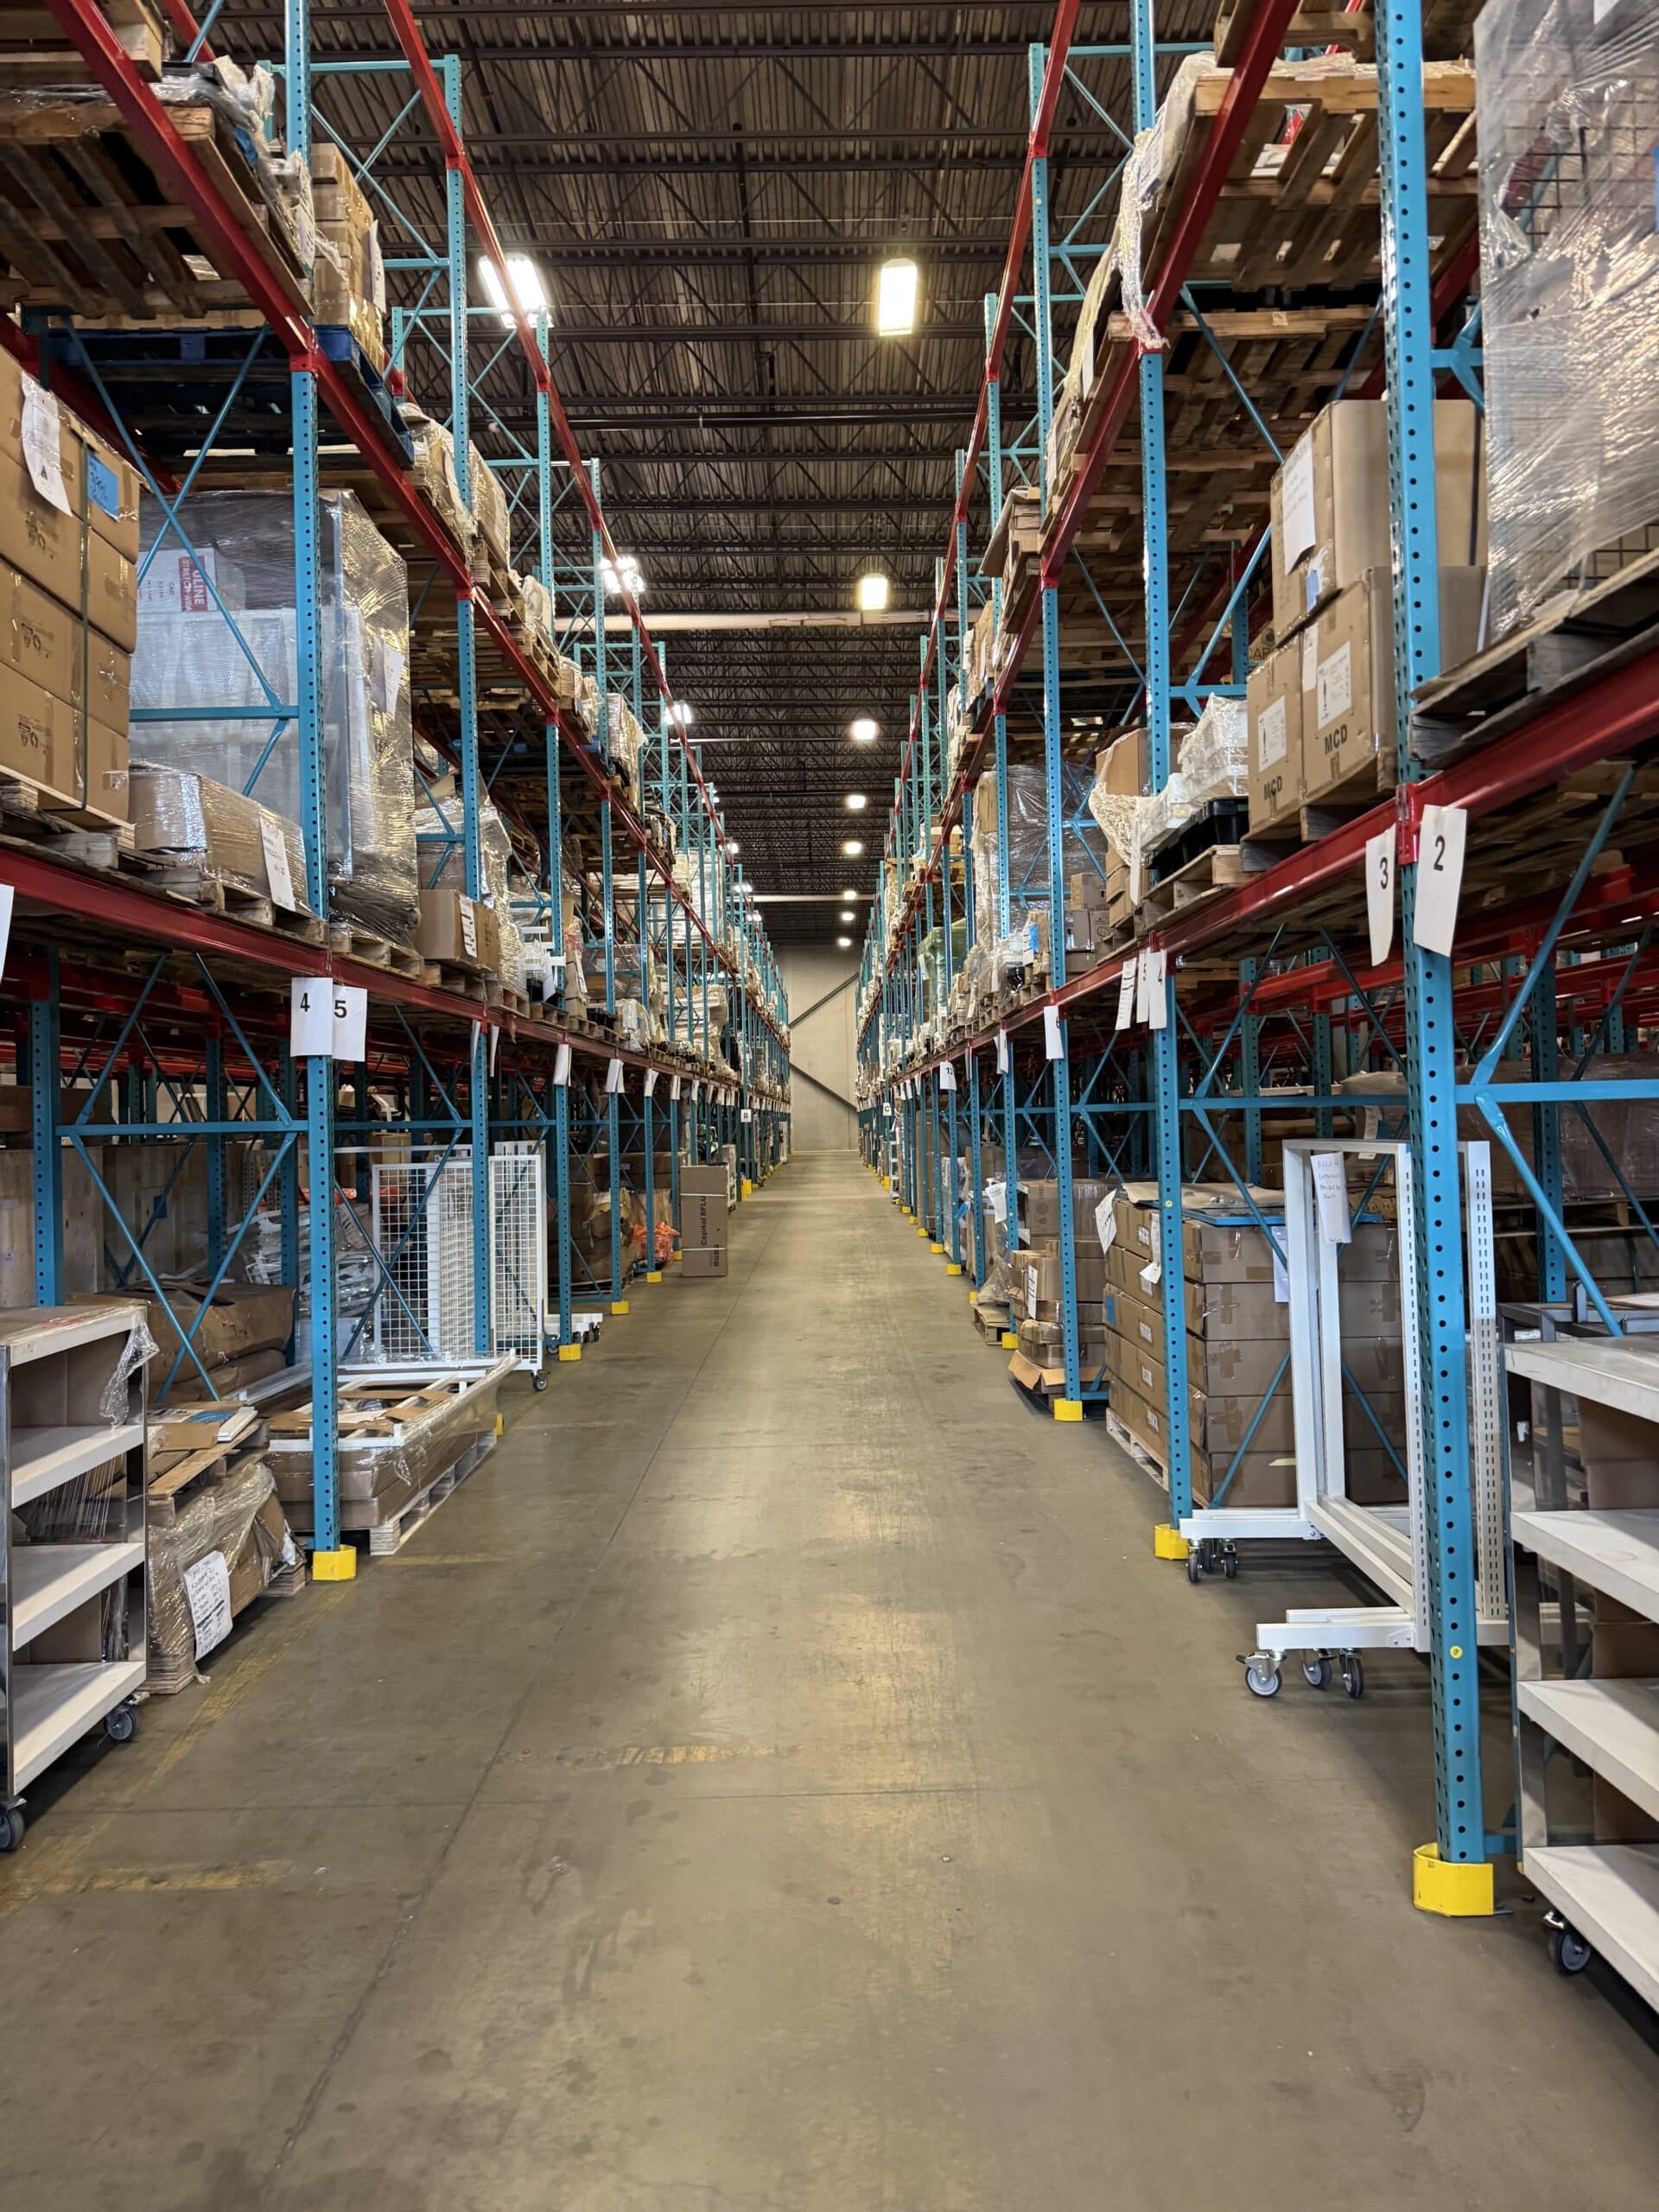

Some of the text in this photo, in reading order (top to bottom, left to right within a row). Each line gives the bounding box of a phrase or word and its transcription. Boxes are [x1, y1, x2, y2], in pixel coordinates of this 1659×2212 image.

[193, 569, 205, 606] ULINE
[1325, 724, 1348, 755] MCD
[1263, 775, 1283, 801] MCD
[1433, 835, 1446, 872] 2
[1379, 856, 1389, 890] 3
[300, 992, 310, 1013] 4
[334, 999, 347, 1019] 5
